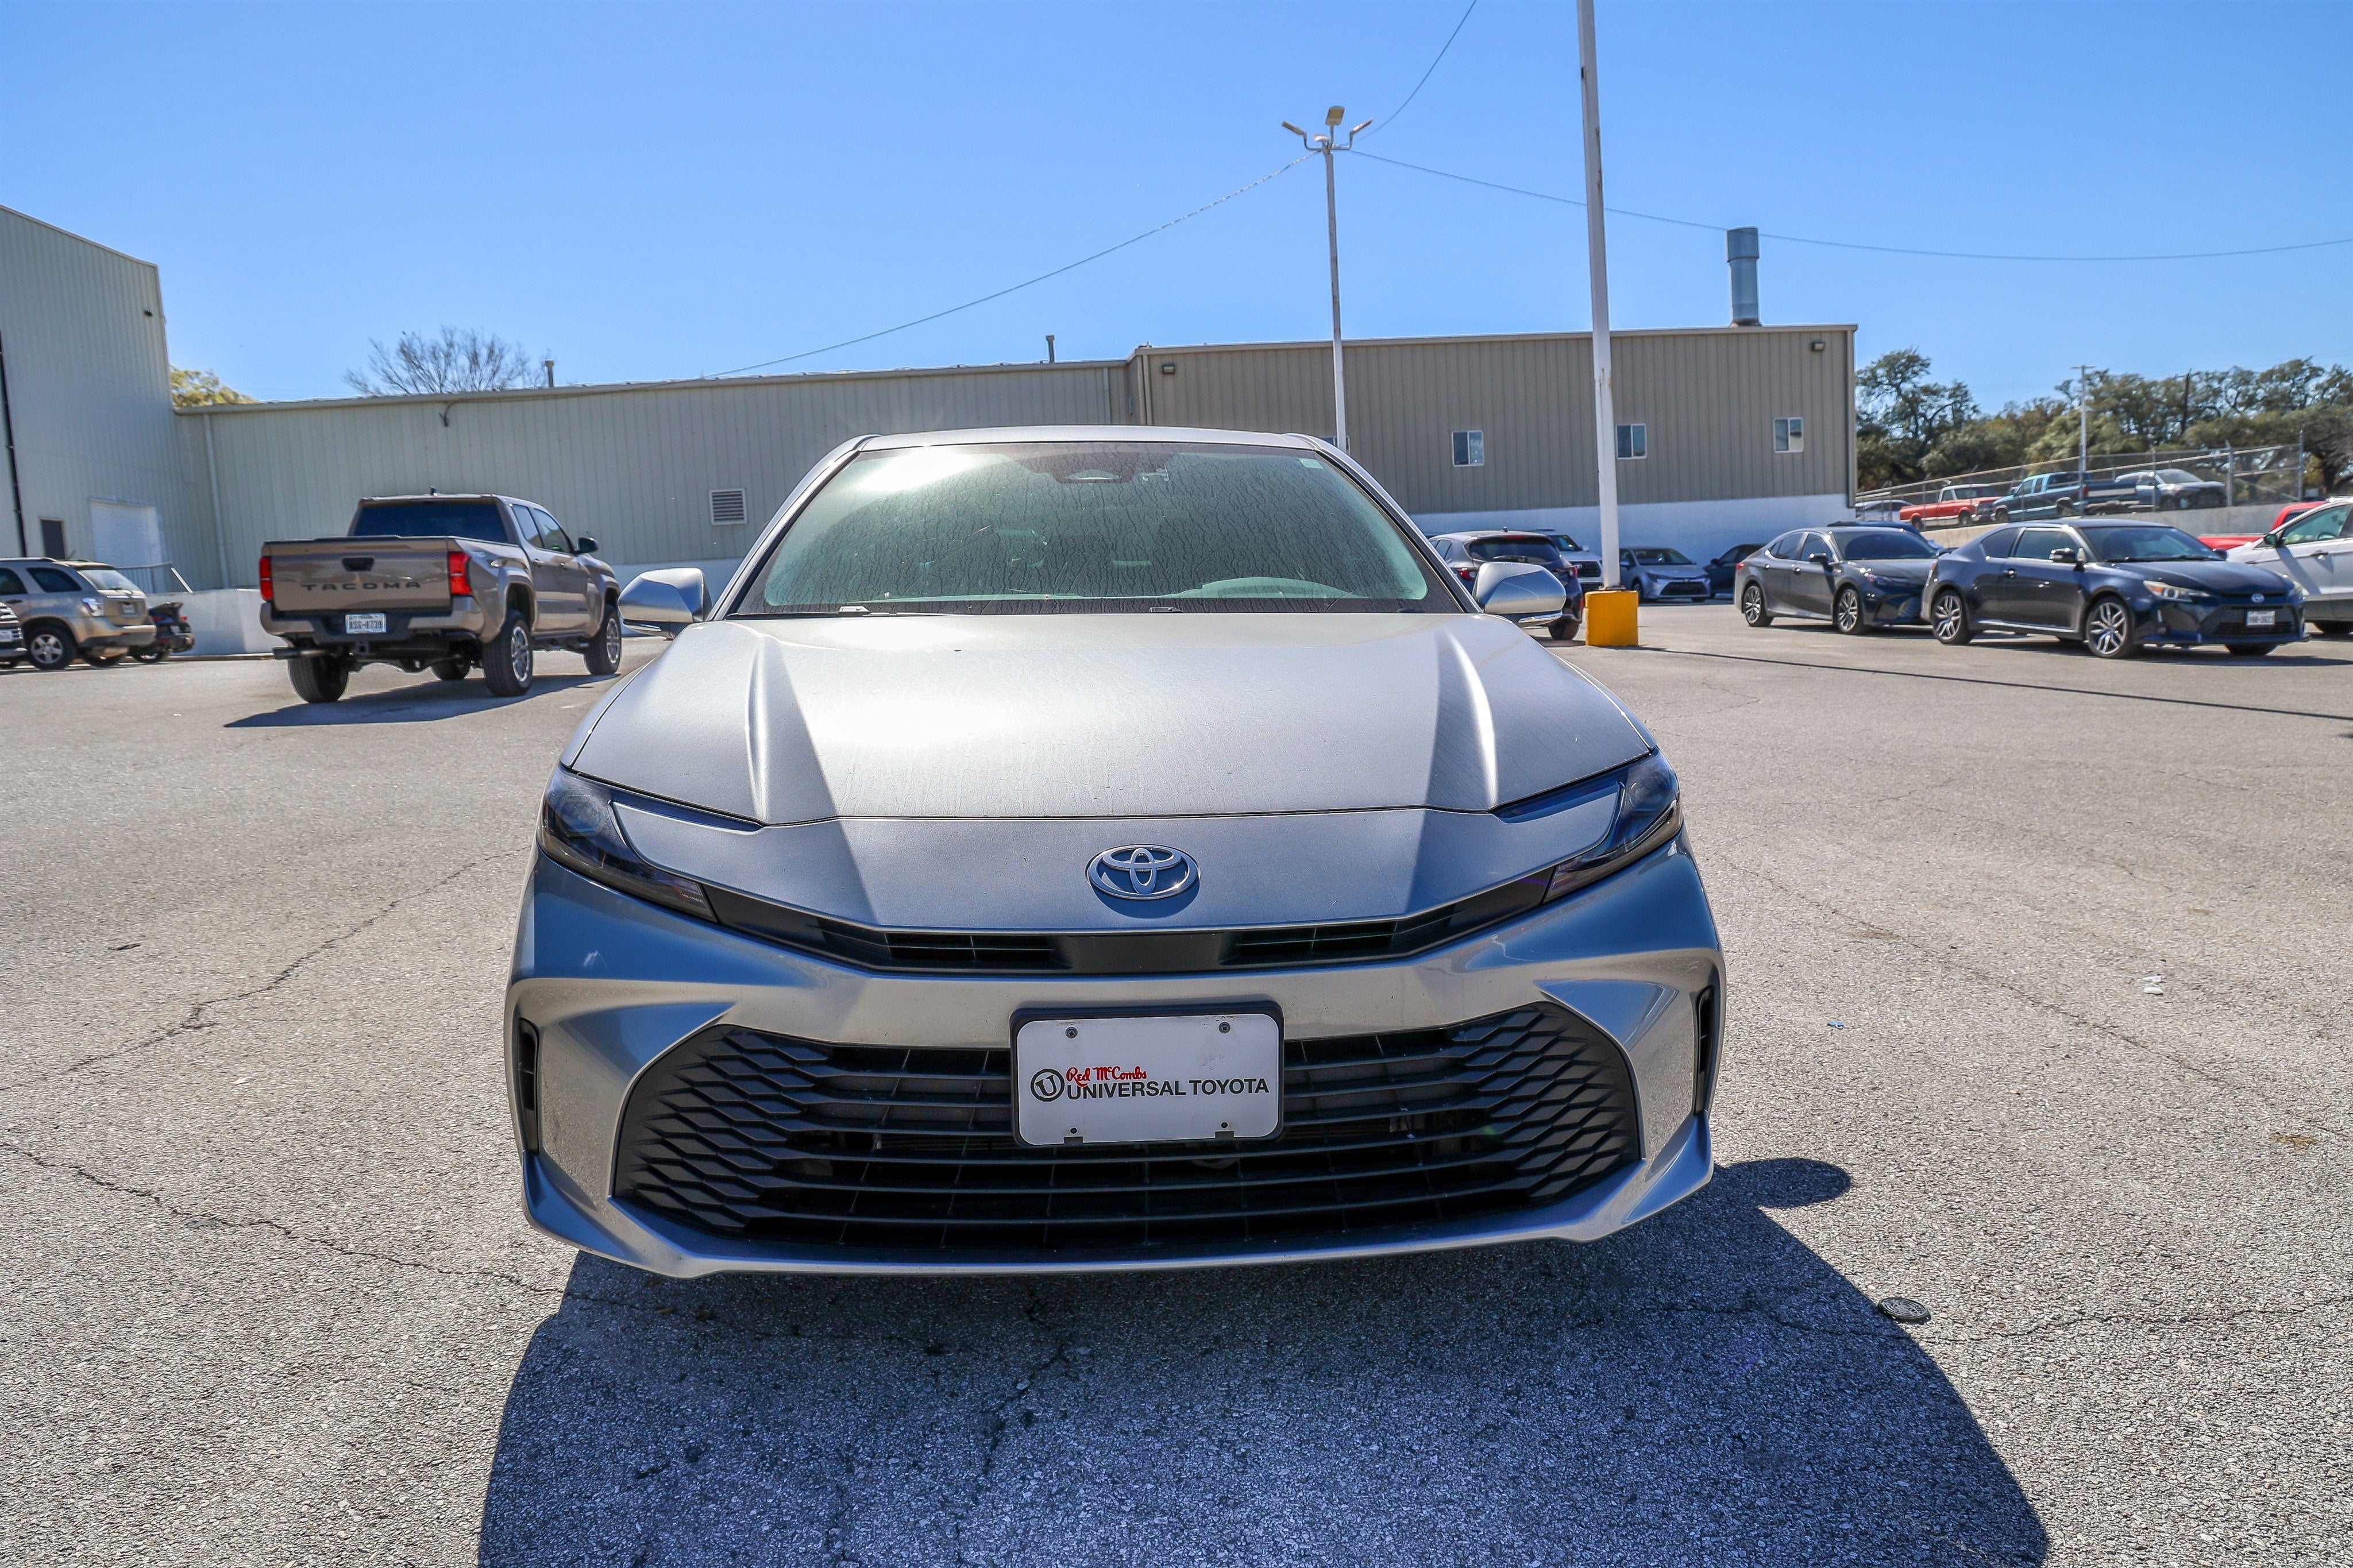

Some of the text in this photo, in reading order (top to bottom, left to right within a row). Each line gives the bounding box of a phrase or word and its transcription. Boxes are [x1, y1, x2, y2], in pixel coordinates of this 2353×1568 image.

[301, 581, 421, 591] TACOMA
[1035, 1074, 1058, 1096] U
[1066, 1065, 1147, 1087] Red McCombs
[1067, 1077, 1270, 1100] UNIVERSAL TOYOTA
